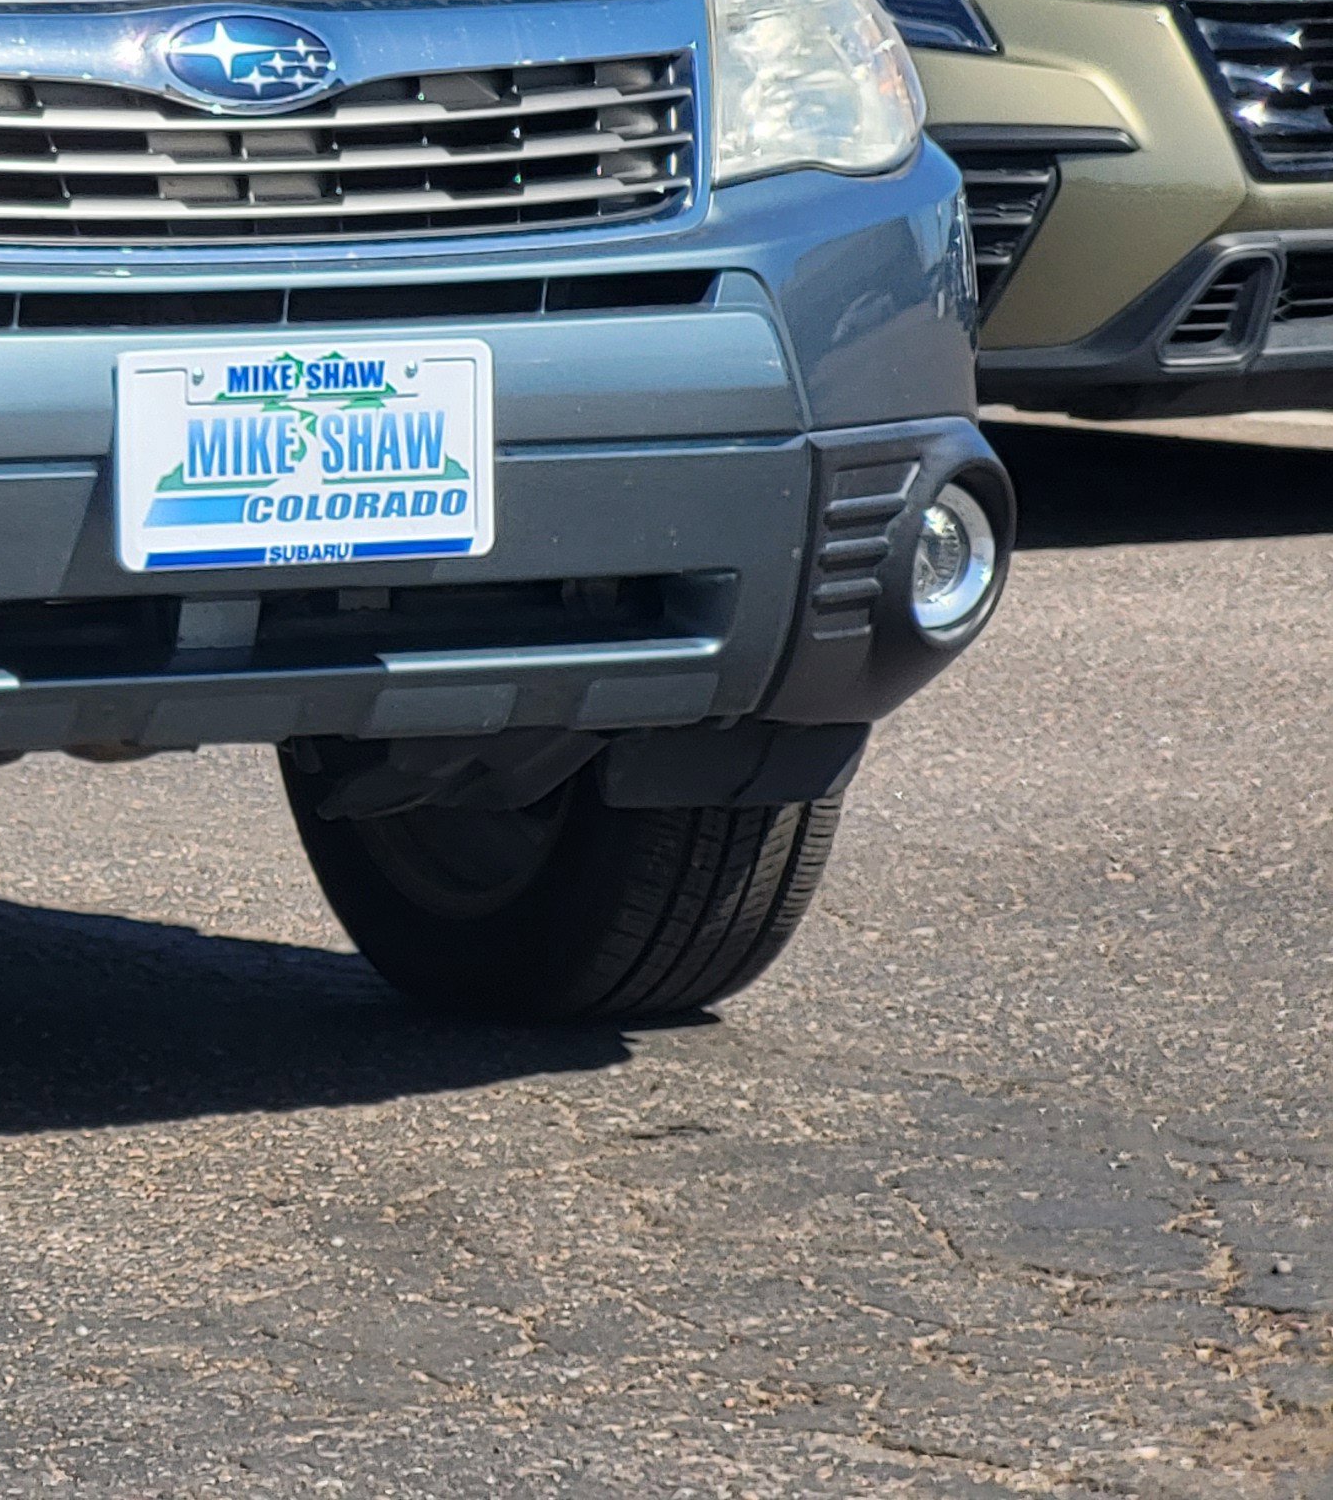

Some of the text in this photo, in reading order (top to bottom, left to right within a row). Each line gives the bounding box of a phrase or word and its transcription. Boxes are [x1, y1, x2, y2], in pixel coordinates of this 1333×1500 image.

[227, 360, 385, 393] MIKE SHAW
[187, 410, 446, 478] MIKE SHAW
[246, 488, 469, 524] COLORADO
[268, 545, 350, 563] SUBARU
